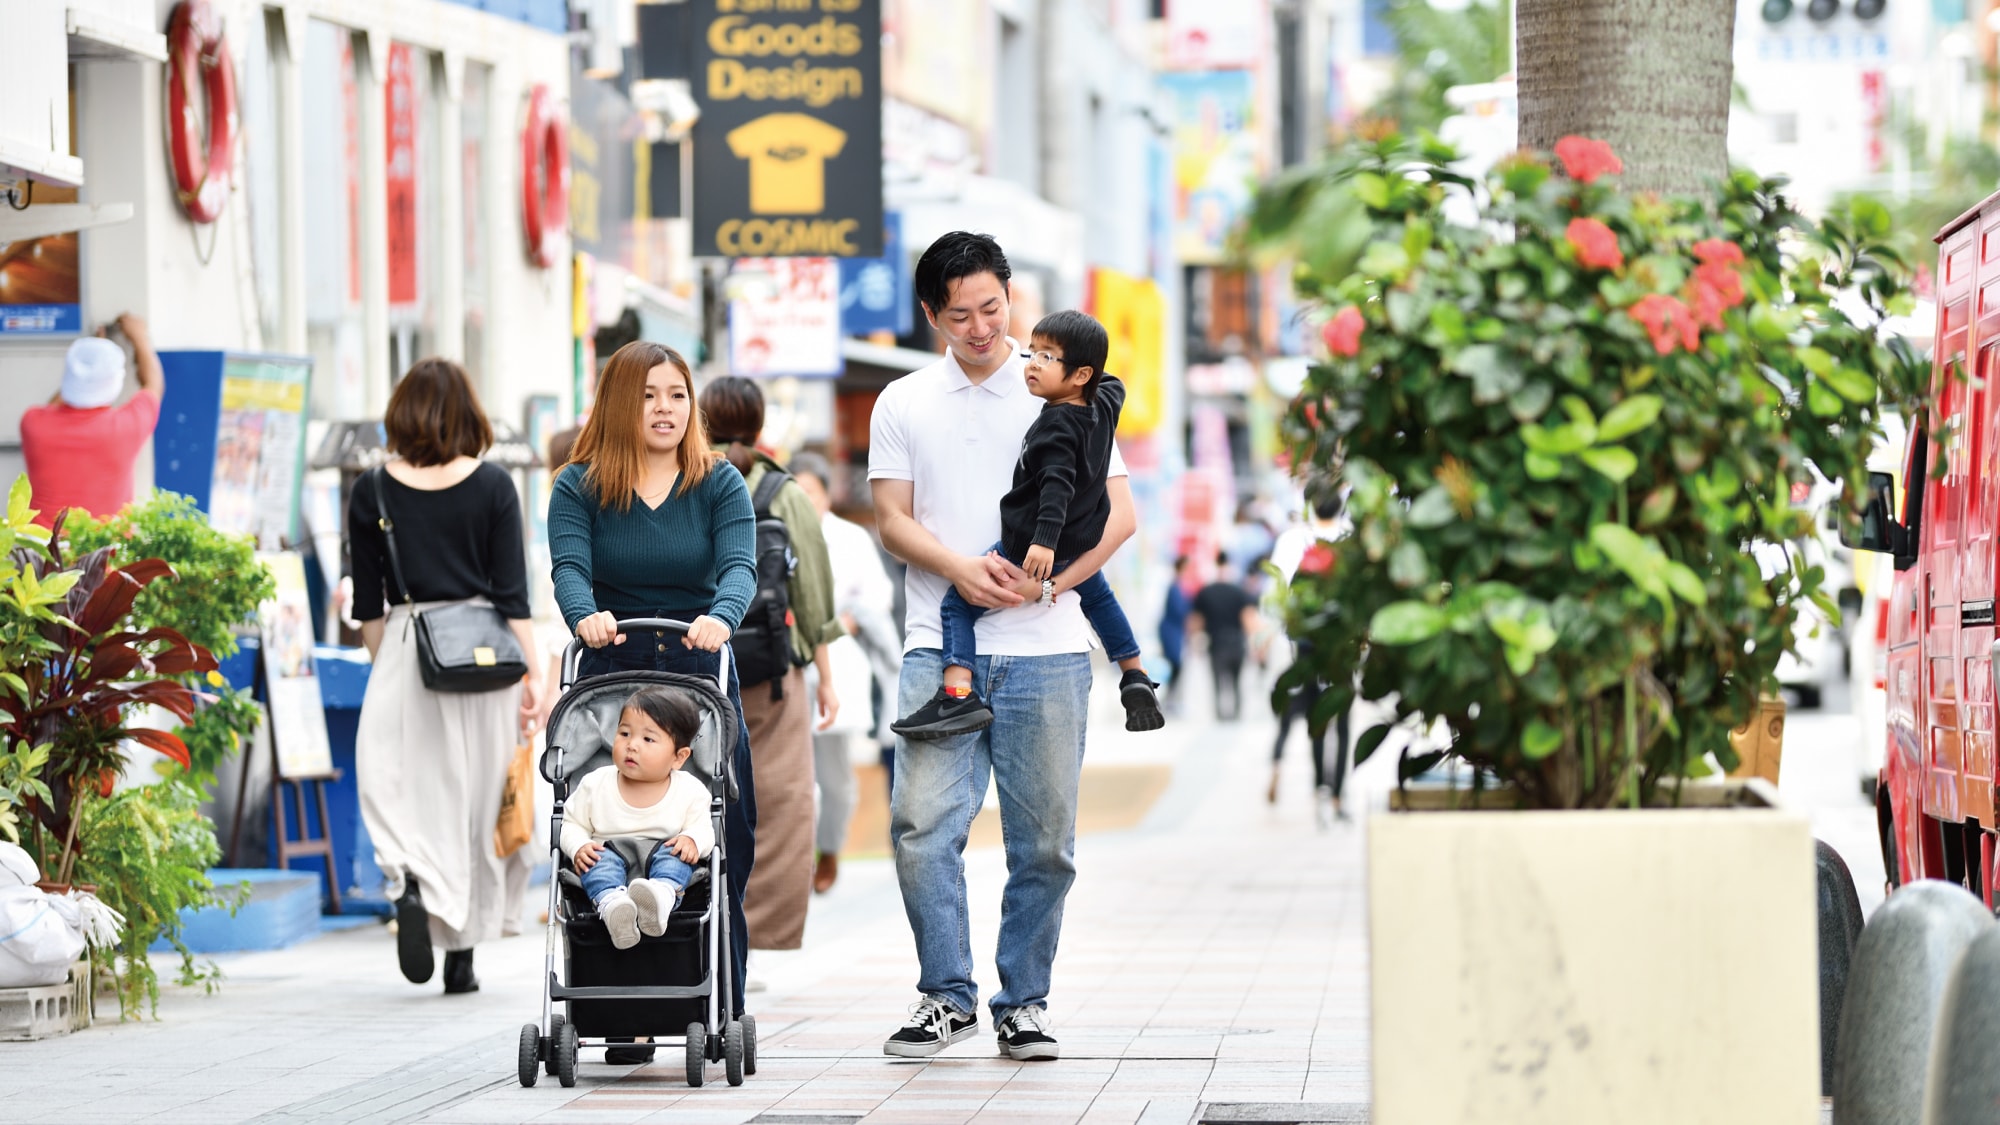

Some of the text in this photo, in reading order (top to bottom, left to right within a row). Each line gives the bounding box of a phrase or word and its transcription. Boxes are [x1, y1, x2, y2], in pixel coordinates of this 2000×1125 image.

[707, 16, 863, 57] Goods
[707, 59, 863, 108] Design
[715, 218, 858, 256] COSMIC
